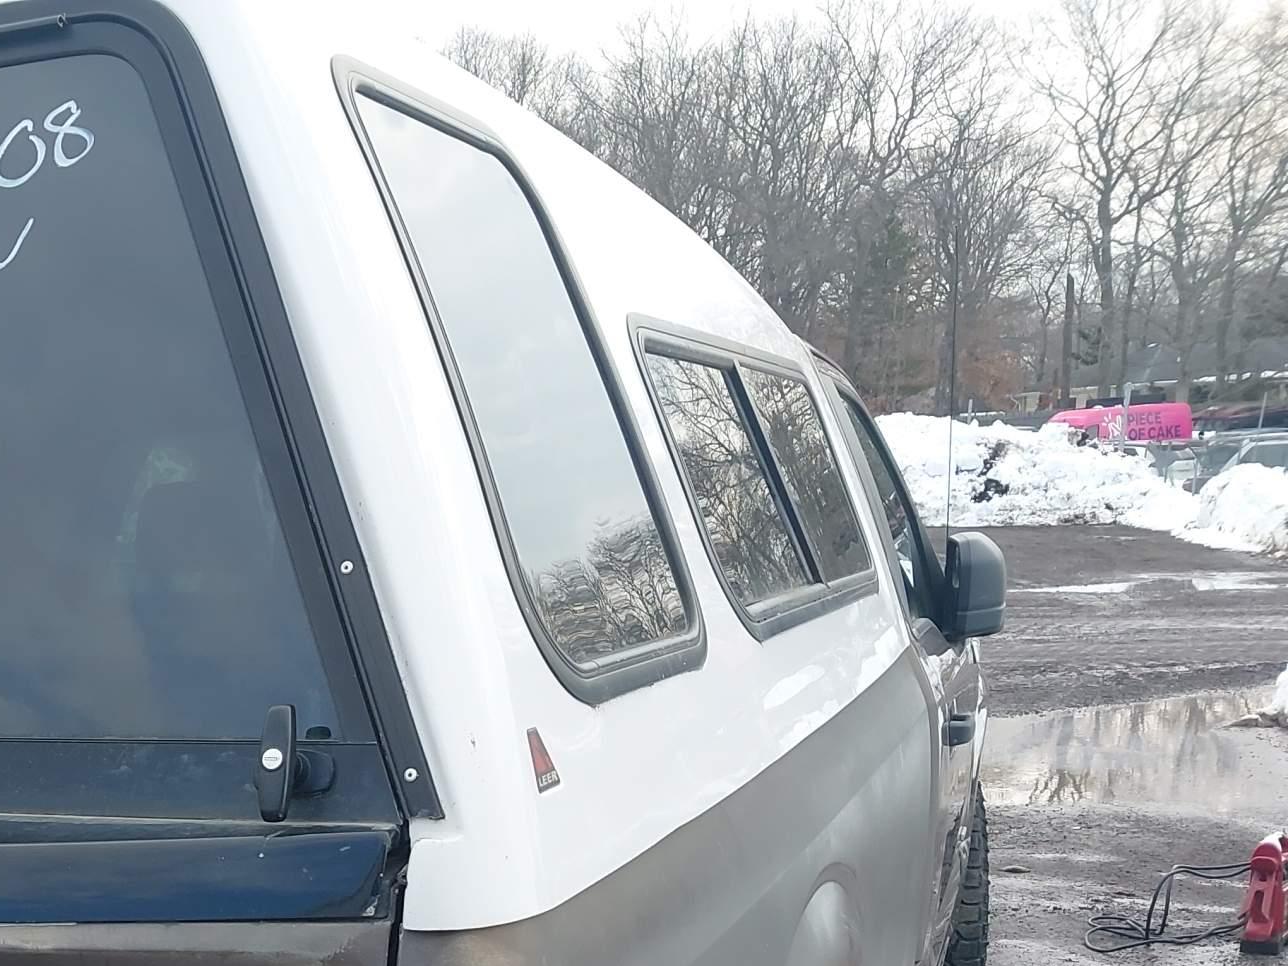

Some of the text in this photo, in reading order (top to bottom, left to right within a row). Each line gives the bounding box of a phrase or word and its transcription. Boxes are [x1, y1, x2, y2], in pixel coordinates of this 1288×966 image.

[1127, 411, 1161, 426] PIECE
[1128, 424, 1182, 441] OF CAKE
[538, 770, 559, 787] LEER
